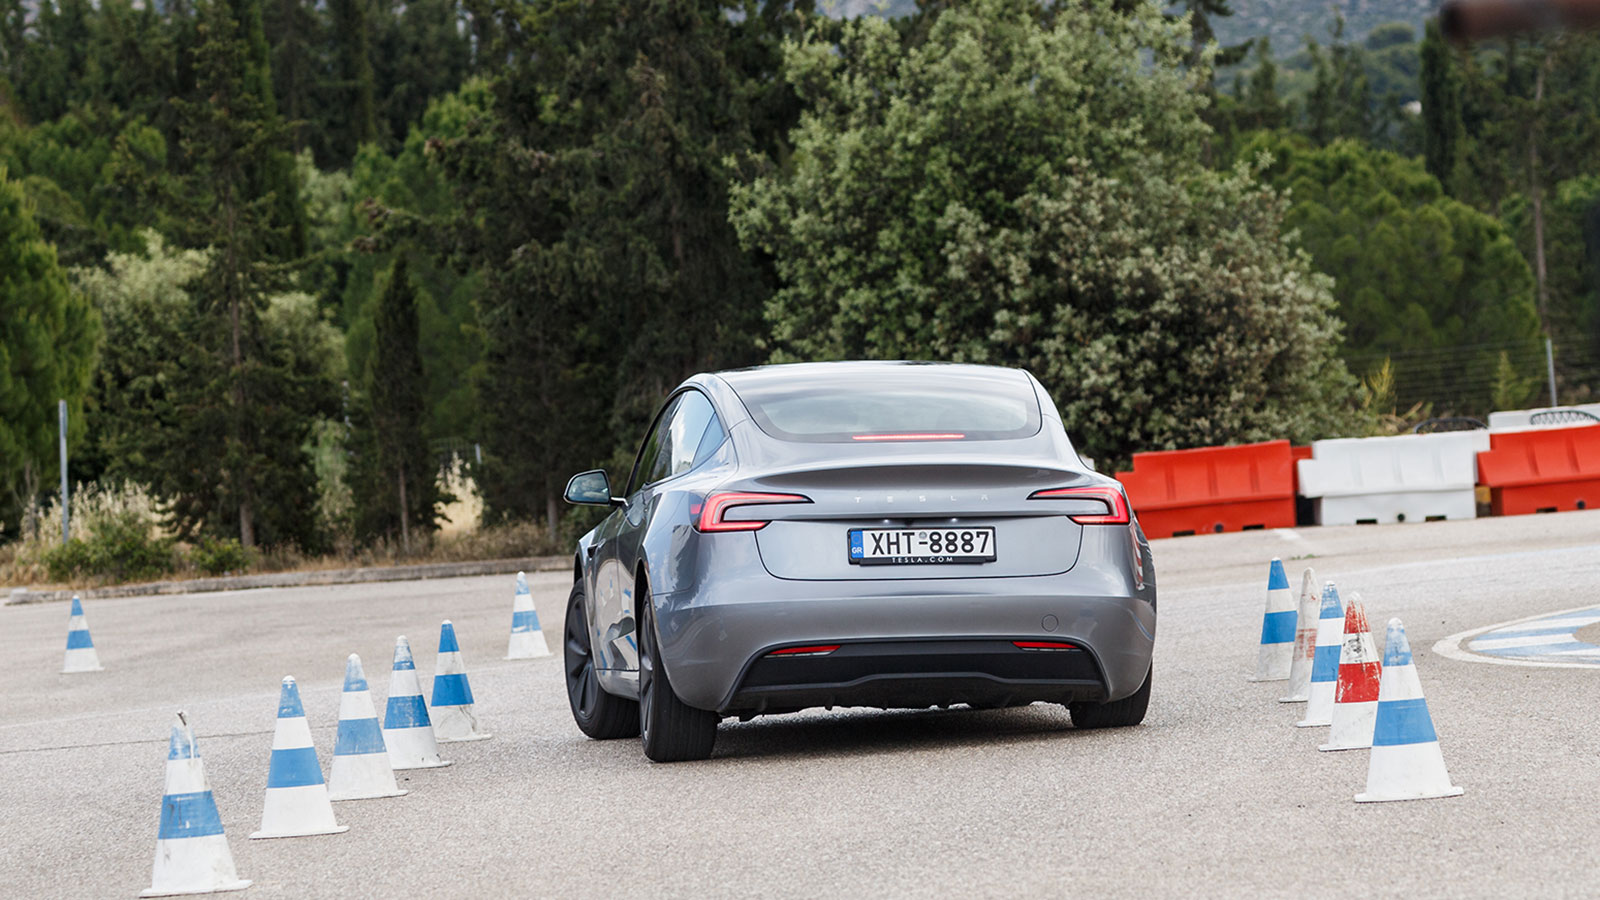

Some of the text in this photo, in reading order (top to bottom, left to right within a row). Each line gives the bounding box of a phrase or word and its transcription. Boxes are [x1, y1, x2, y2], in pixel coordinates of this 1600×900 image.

[854, 495, 989, 503] TESLA
[871, 531, 990, 555] XHT-8887
[851, 546, 863, 554] GR
